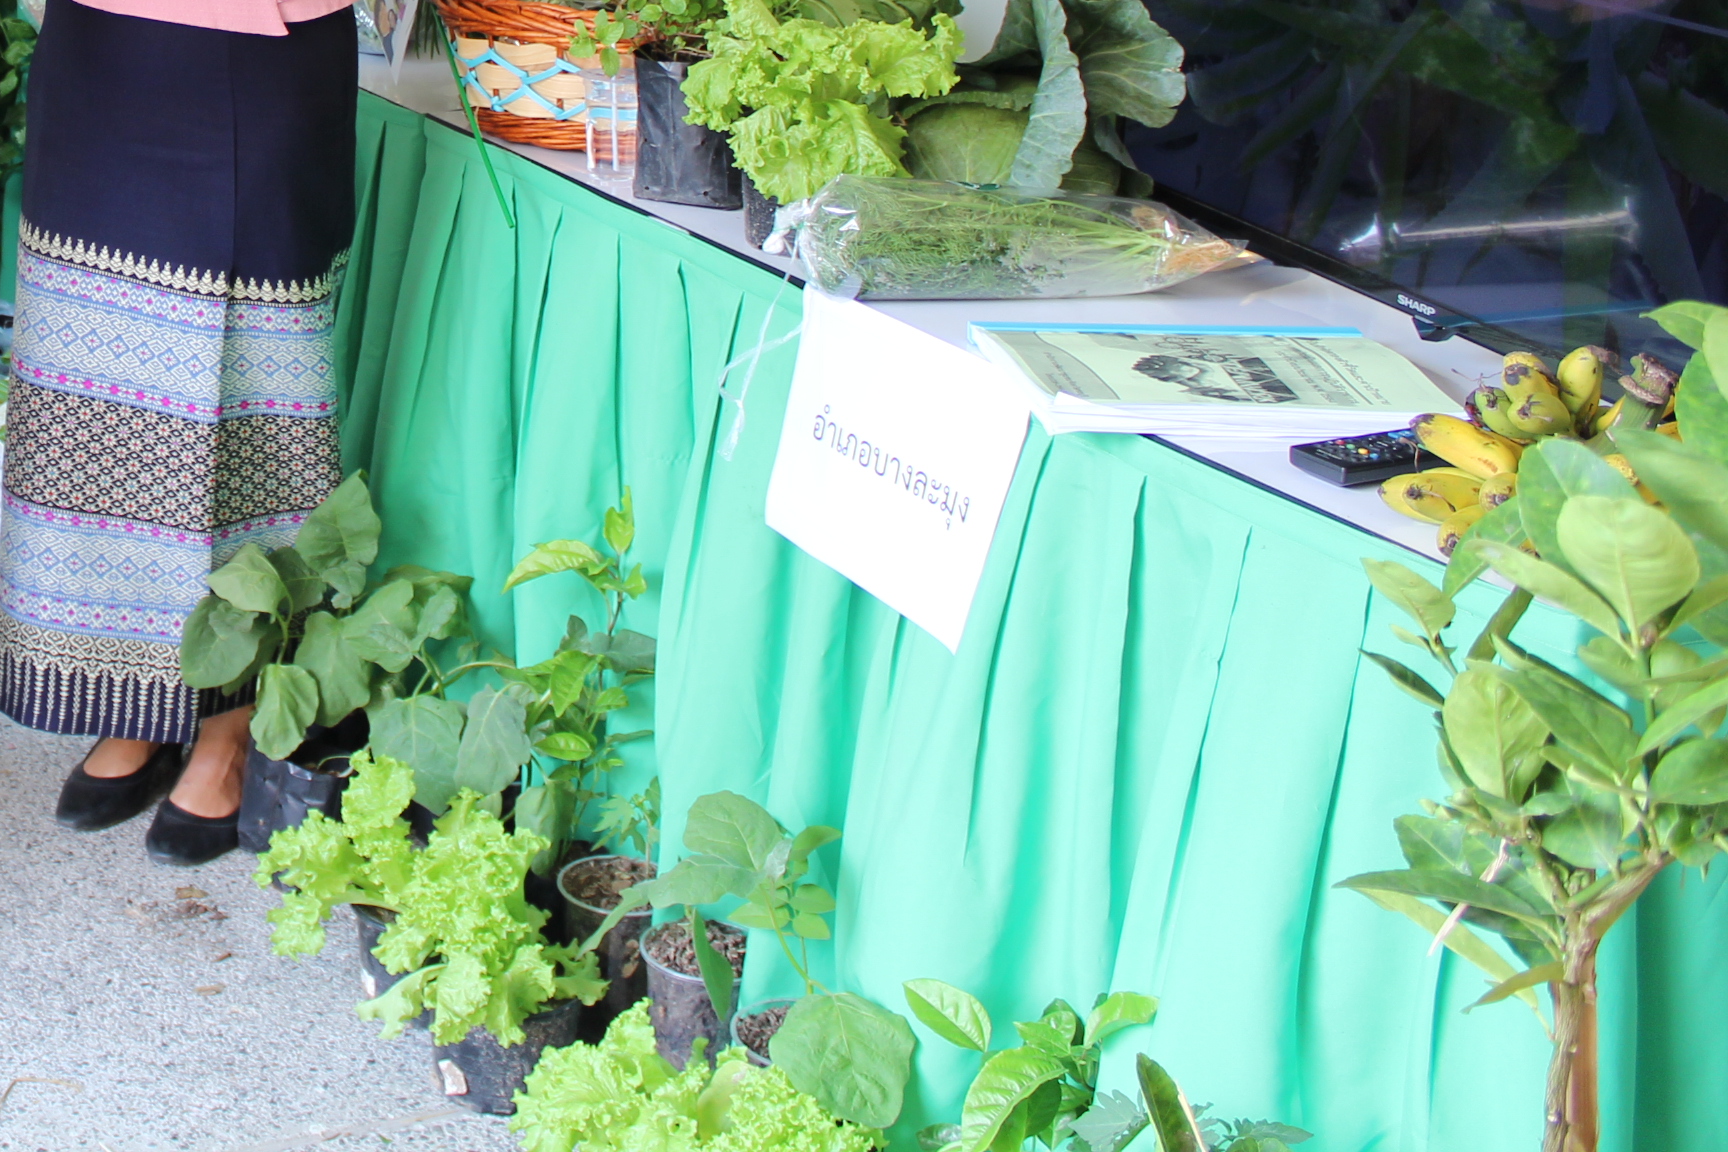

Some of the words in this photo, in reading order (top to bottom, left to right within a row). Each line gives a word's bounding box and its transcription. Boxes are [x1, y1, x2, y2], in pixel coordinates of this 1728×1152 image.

[1396, 293, 1436, 316] SHARP
[812, 404, 971, 531] อำเภอบางละมุง
